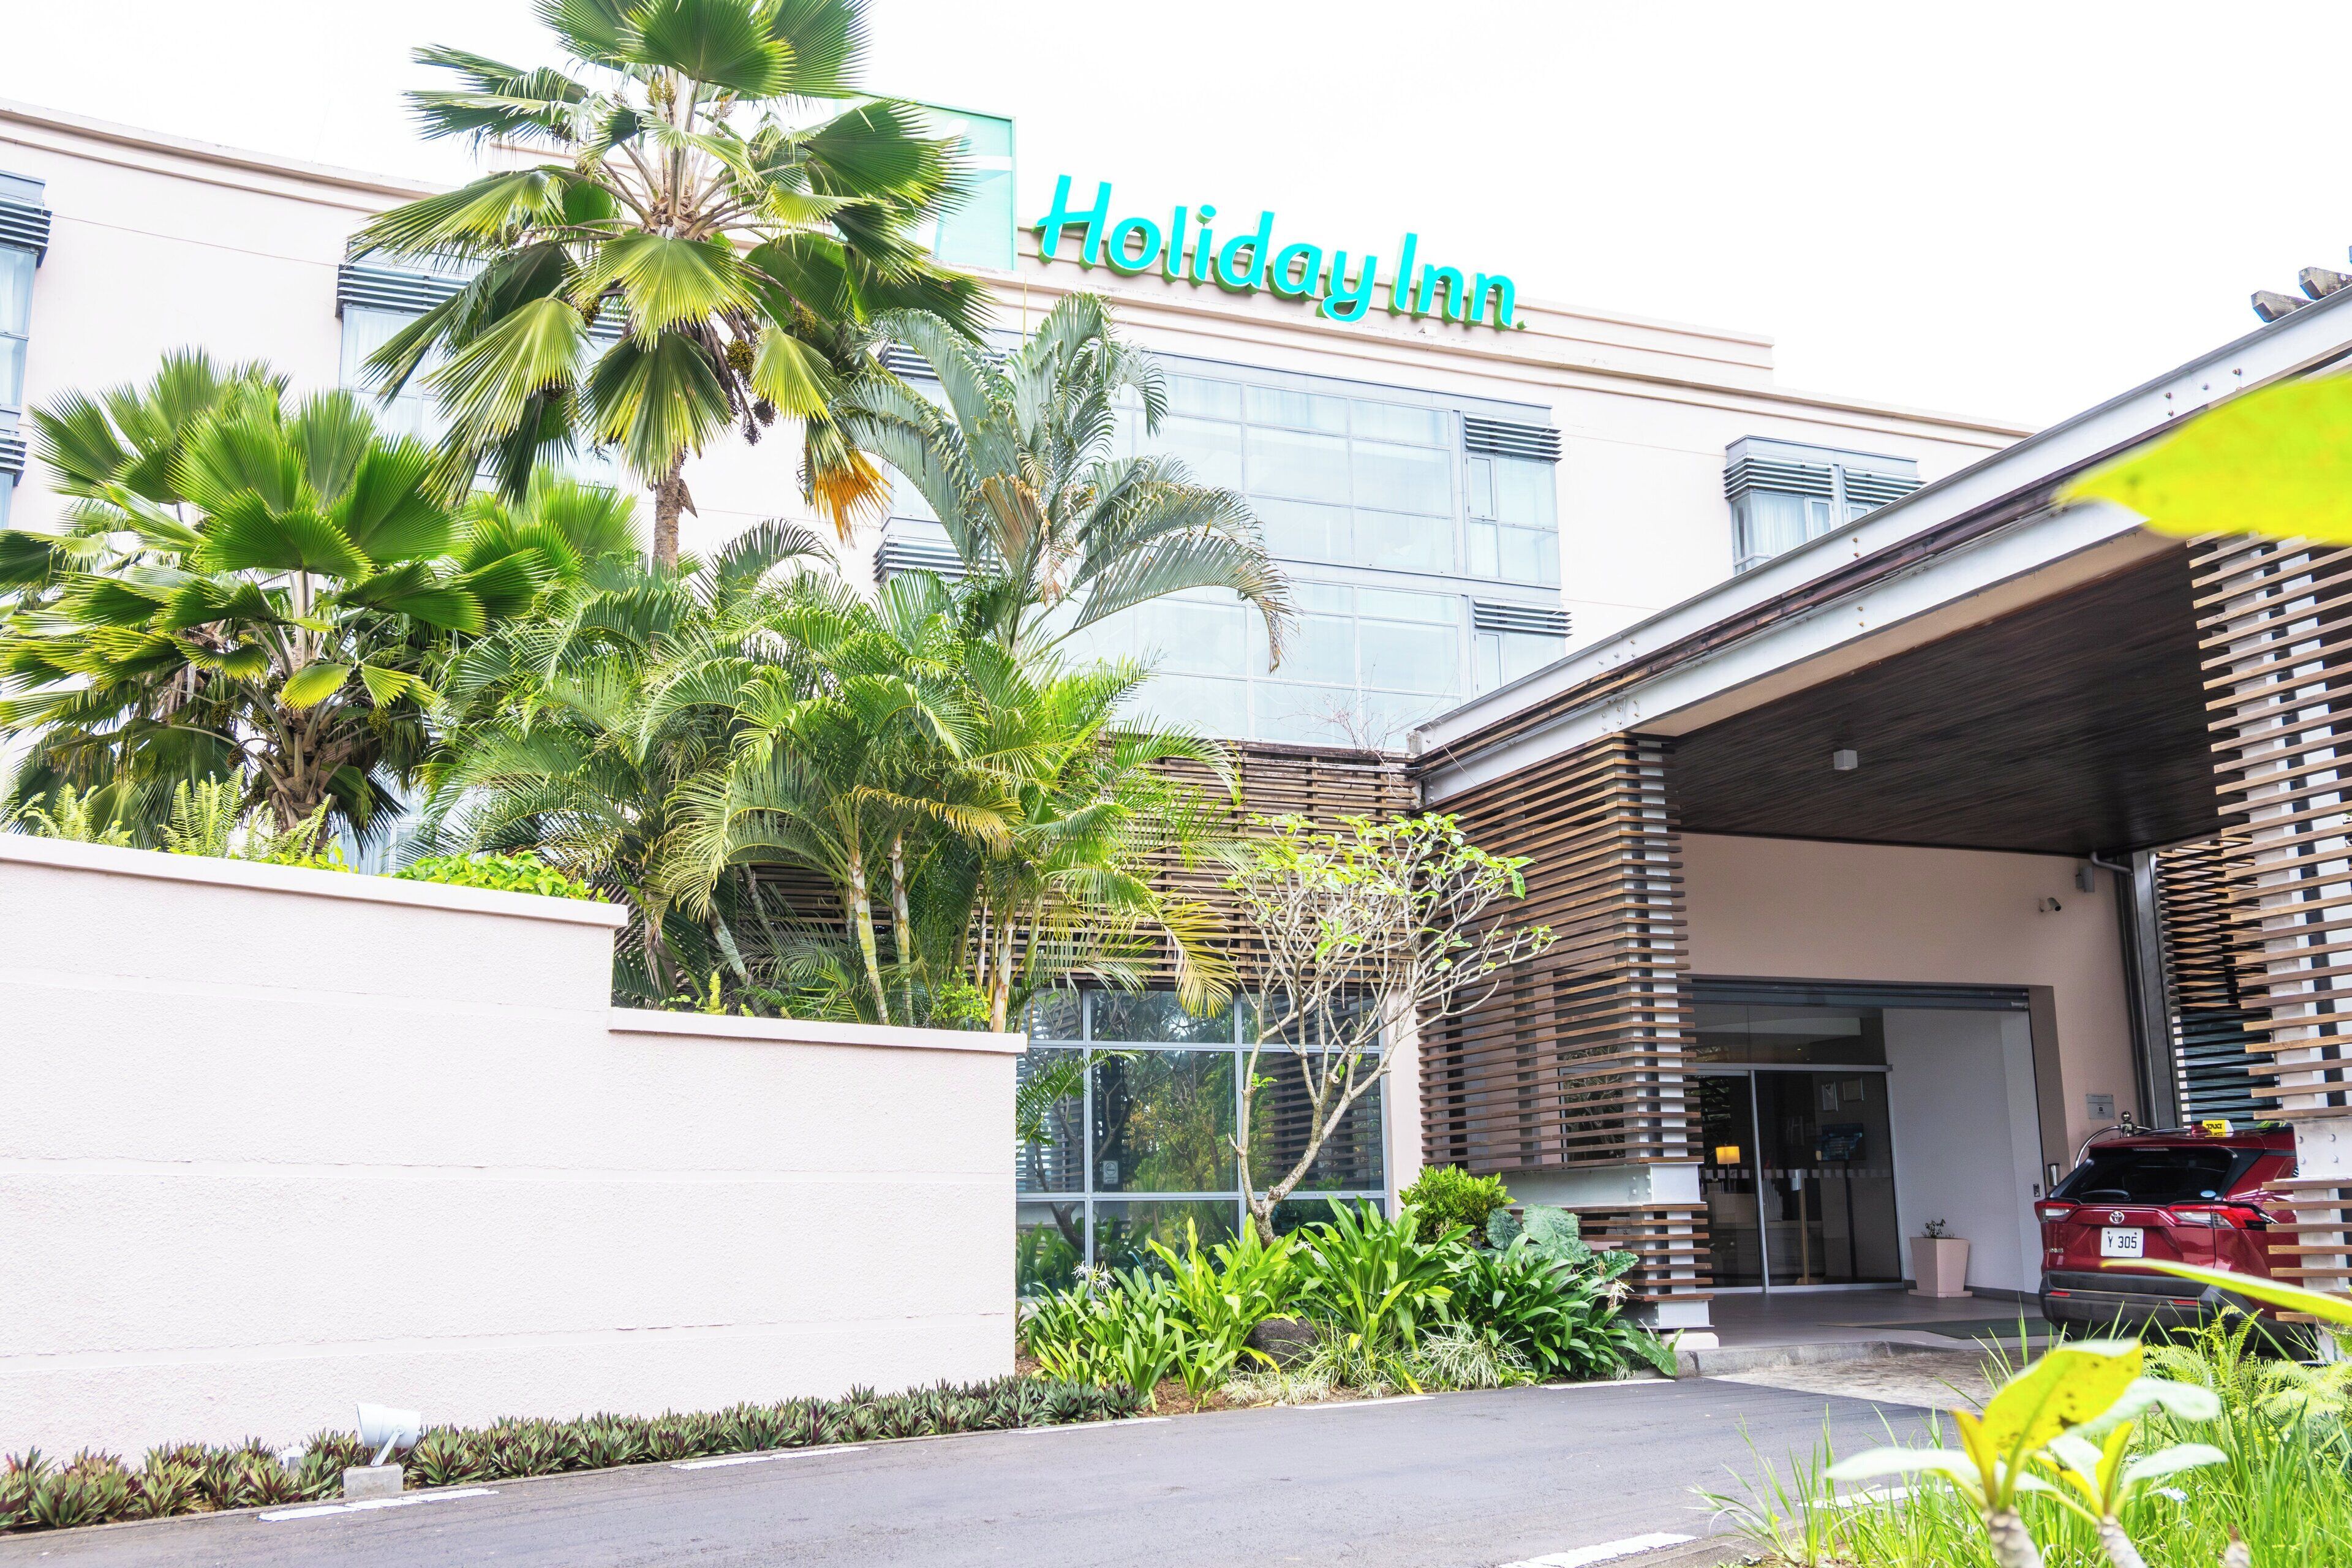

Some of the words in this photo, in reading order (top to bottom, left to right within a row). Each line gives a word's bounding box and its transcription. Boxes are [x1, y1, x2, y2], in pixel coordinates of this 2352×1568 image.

[1035, 174, 1378, 323] Holiday
[1395, 232, 1516, 327] Inn
[2108, 1235, 2113, 1248] Y
[2117, 1235, 2137, 1249] 305
